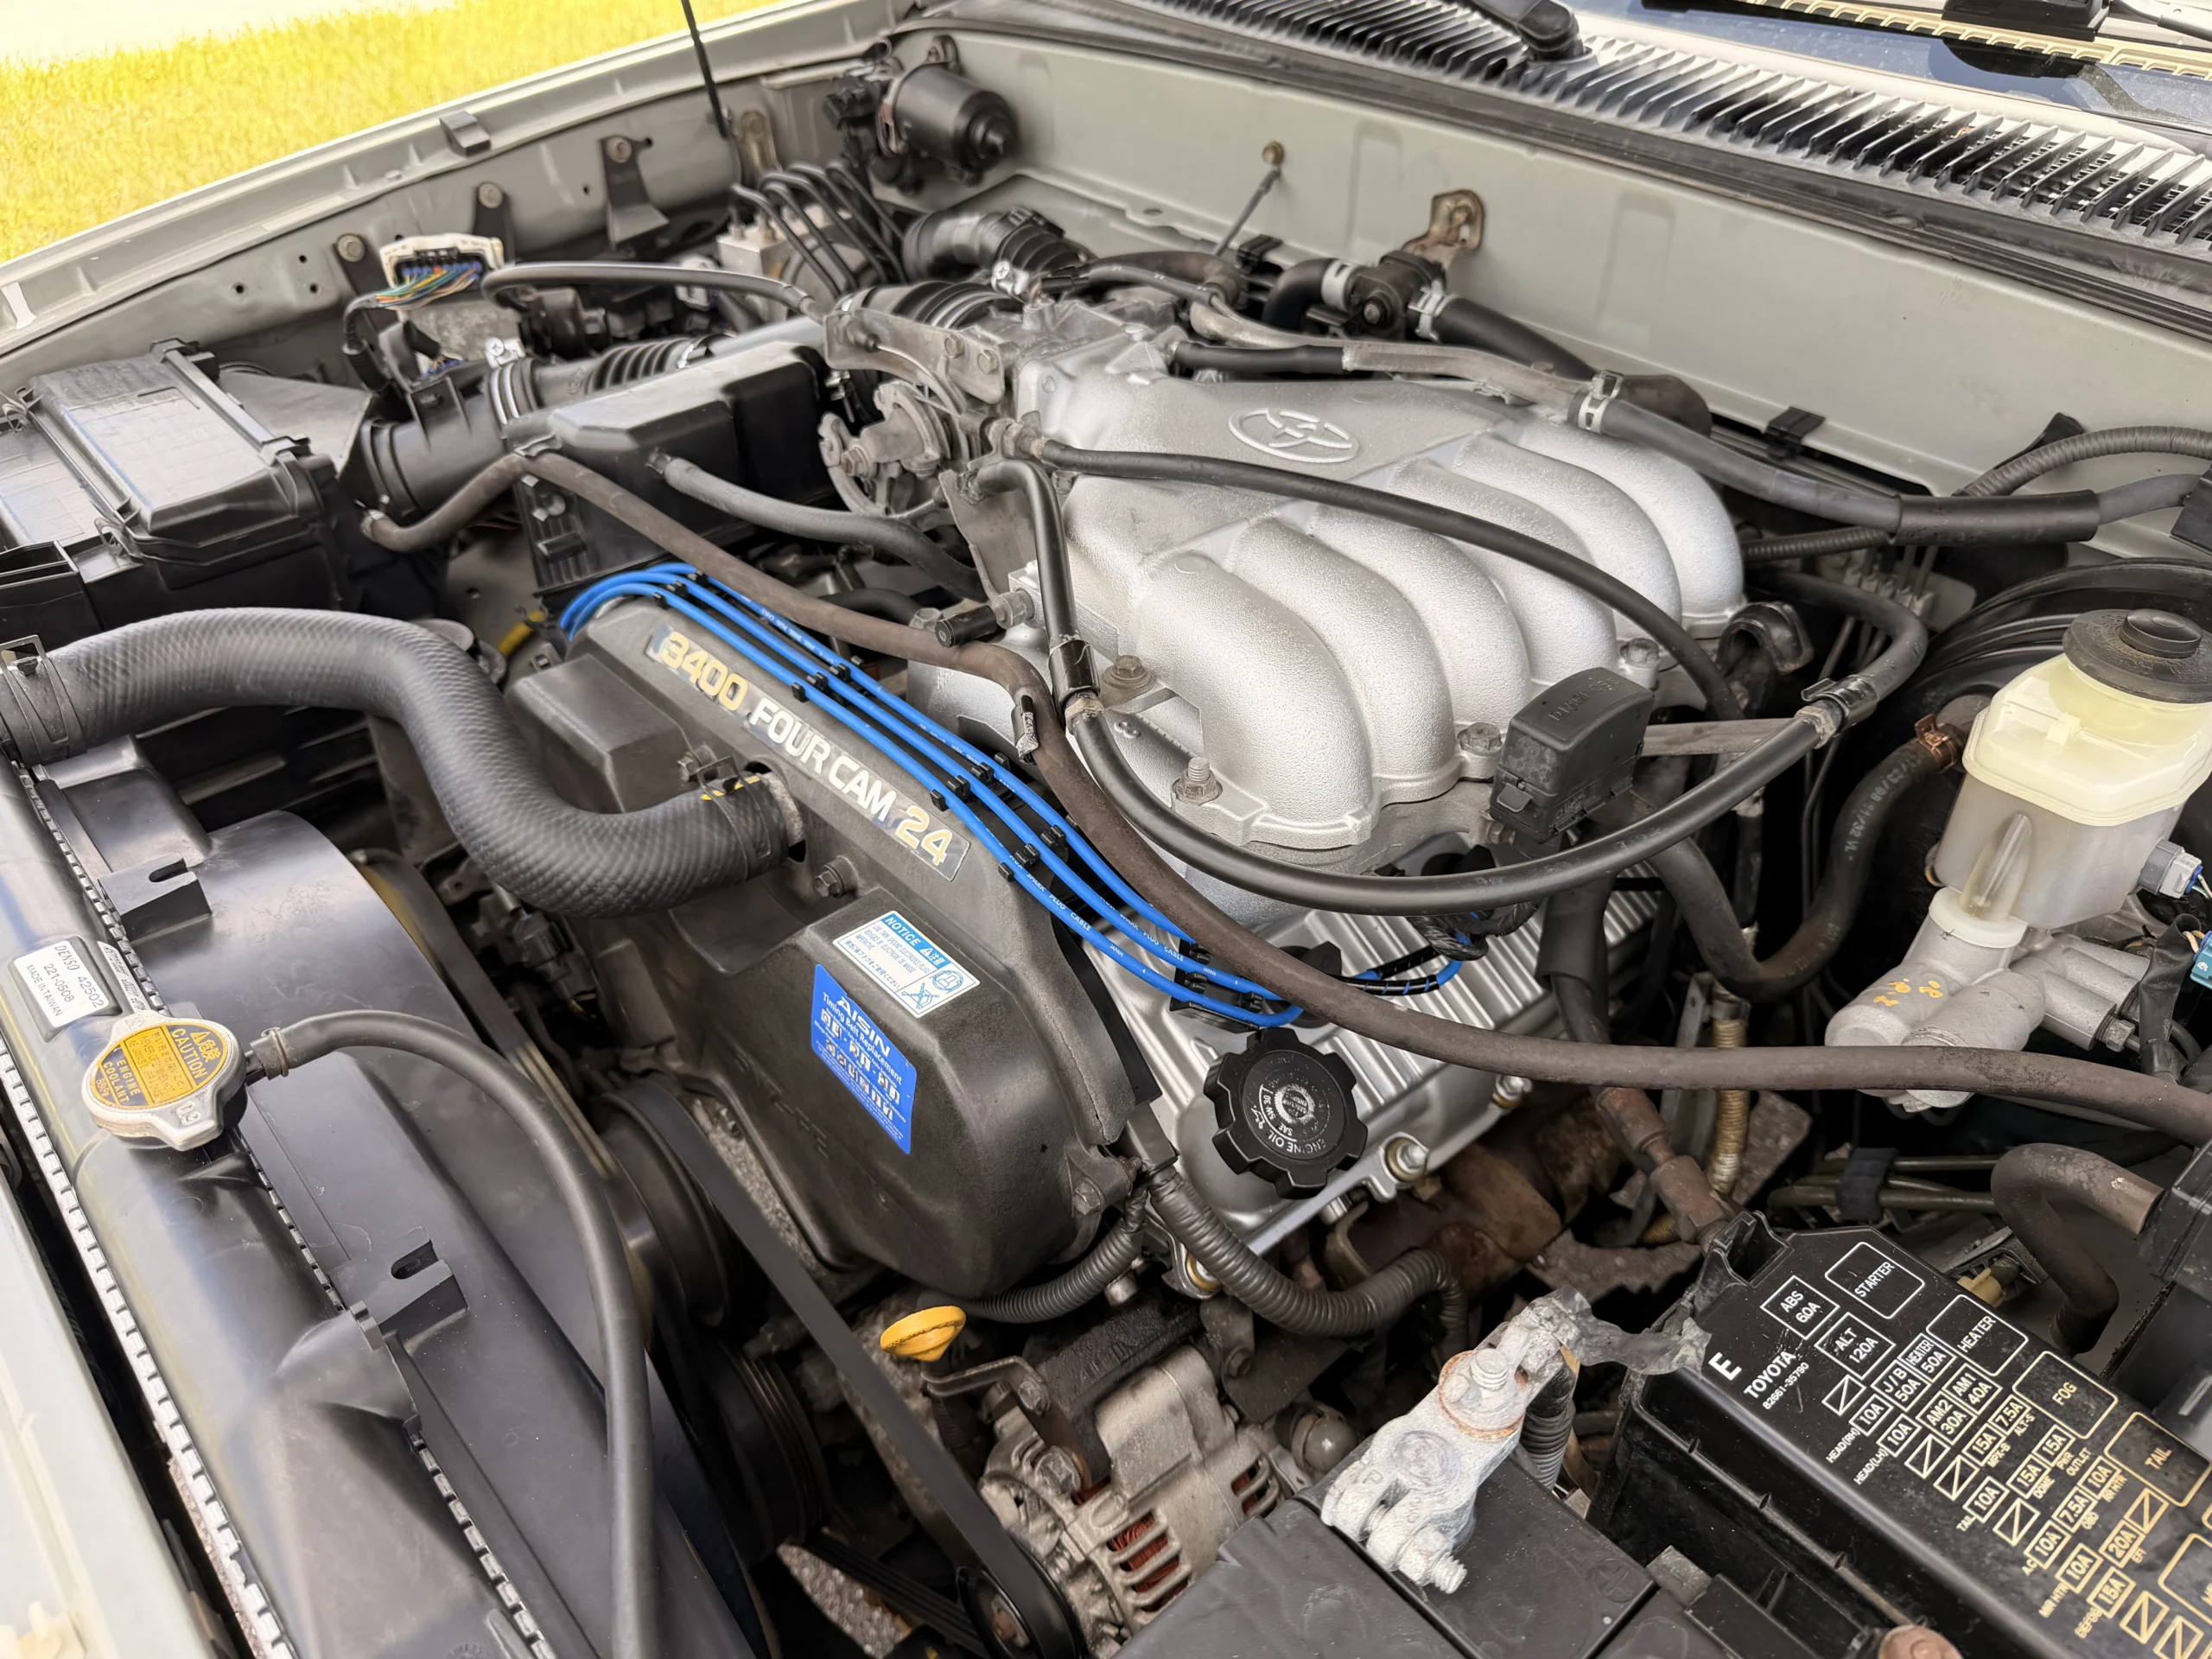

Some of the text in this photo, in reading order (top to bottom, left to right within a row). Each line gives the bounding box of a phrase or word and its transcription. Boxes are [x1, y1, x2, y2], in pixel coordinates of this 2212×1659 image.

[660, 632, 749, 711] 3400
[748, 697, 831, 775] FOUR
[829, 755, 897, 822] CAM
[894, 804, 953, 866] 24
[1026, 873, 1046, 892] SPARK
[1048, 893, 1067, 910] PLUG
[1070, 912, 1092, 931] CABLE
[885, 917, 921, 946] NOTICE
[1142, 931, 1160, 946] PLUG
[1164, 946, 1185, 963] CABLE
[43, 963, 75, 1002] 221-0508
[54, 944, 105, 1008] DENSO 42502
[25, 964, 63, 1017] MADE IN TAIWAN
[823, 991, 845, 1023] Timing
[846, 1016, 860, 1037] Belt
[860, 1033, 903, 1085] Replacement
[836, 995, 891, 1058] AISIN
[172, 1028, 208, 1079] CAUTION
[198, 1039, 221, 1064] 危険
[103, 1061, 130, 1103] COOLANT
[116, 1059, 141, 1096] ENGINE
[1262, 1094, 1276, 1120] 5W-30
[1268, 1128, 1285, 1147] OIL
[1278, 1122, 1294, 1136] SAE
[1854, 1261, 1896, 1297] STARTER
[1780, 1290, 1804, 1313] ABS
[1796, 1302, 1821, 1323] 60A
[1835, 1327, 1858, 1351] ALT
[1956, 1315, 1997, 1353] HEATER
[1849, 1337, 1878, 1364] 120A
[1905, 1339, 1935, 1366] HEATER
[1921, 1351, 1947, 1374] 50A
[1708, 1351, 1742, 1381] E
[1744, 1351, 1796, 1399] TOYOTA
[1762, 1362, 1810, 1410] 82661-35790
[1884, 1367, 1908, 1394] J/B
[1894, 1379, 1922, 1402] 50A
[1952, 1372, 1977, 1397] AM1
[1967, 1382, 1993, 1405] 40A
[2051, 1382, 2078, 1407] FOG
[1859, 1402, 1885, 1426] 10A
[1926, 1399, 1953, 1427] AM2
[1940, 1410, 1967, 1435] 30A
[1994, 1402, 2024, 1427] 7.5A
[2013, 1414, 2037, 1437] ALT-S
[1825, 1427, 1861, 1464] HEAD(RH)
[1887, 1422, 1913, 1446] 10A
[1972, 1432, 1998, 1455] 15A
[2042, 1435, 2068, 1456] 15A
[1853, 1447, 1890, 1485] HEAD(LH)
[1987, 1441, 2012, 1468] MPX-B
[2056, 1452, 2075, 1471] PWR
[2066, 1446, 2092, 1477] OUTLET
[2144, 1447, 2173, 1470] TAIL
[2017, 1464, 2042, 1486] 15A
[2032, 1475, 2056, 1500] DOME
[2087, 1465, 2113, 1487] 10A
[1974, 1486, 2000, 1511] 10A
[2059, 1495, 2089, 1523] 7.5A
[1955, 1515, 1976, 1532] TAIL
[2081, 1511, 2100, 1530] OBD
[2035, 1530, 2062, 1557] 10A
[2108, 1529, 2137, 1559] 20A
[2131, 1548, 2147, 1564] EFI
[2066, 1554, 2094, 1581] 10A
[2098, 1578, 2126, 1605] 15A
